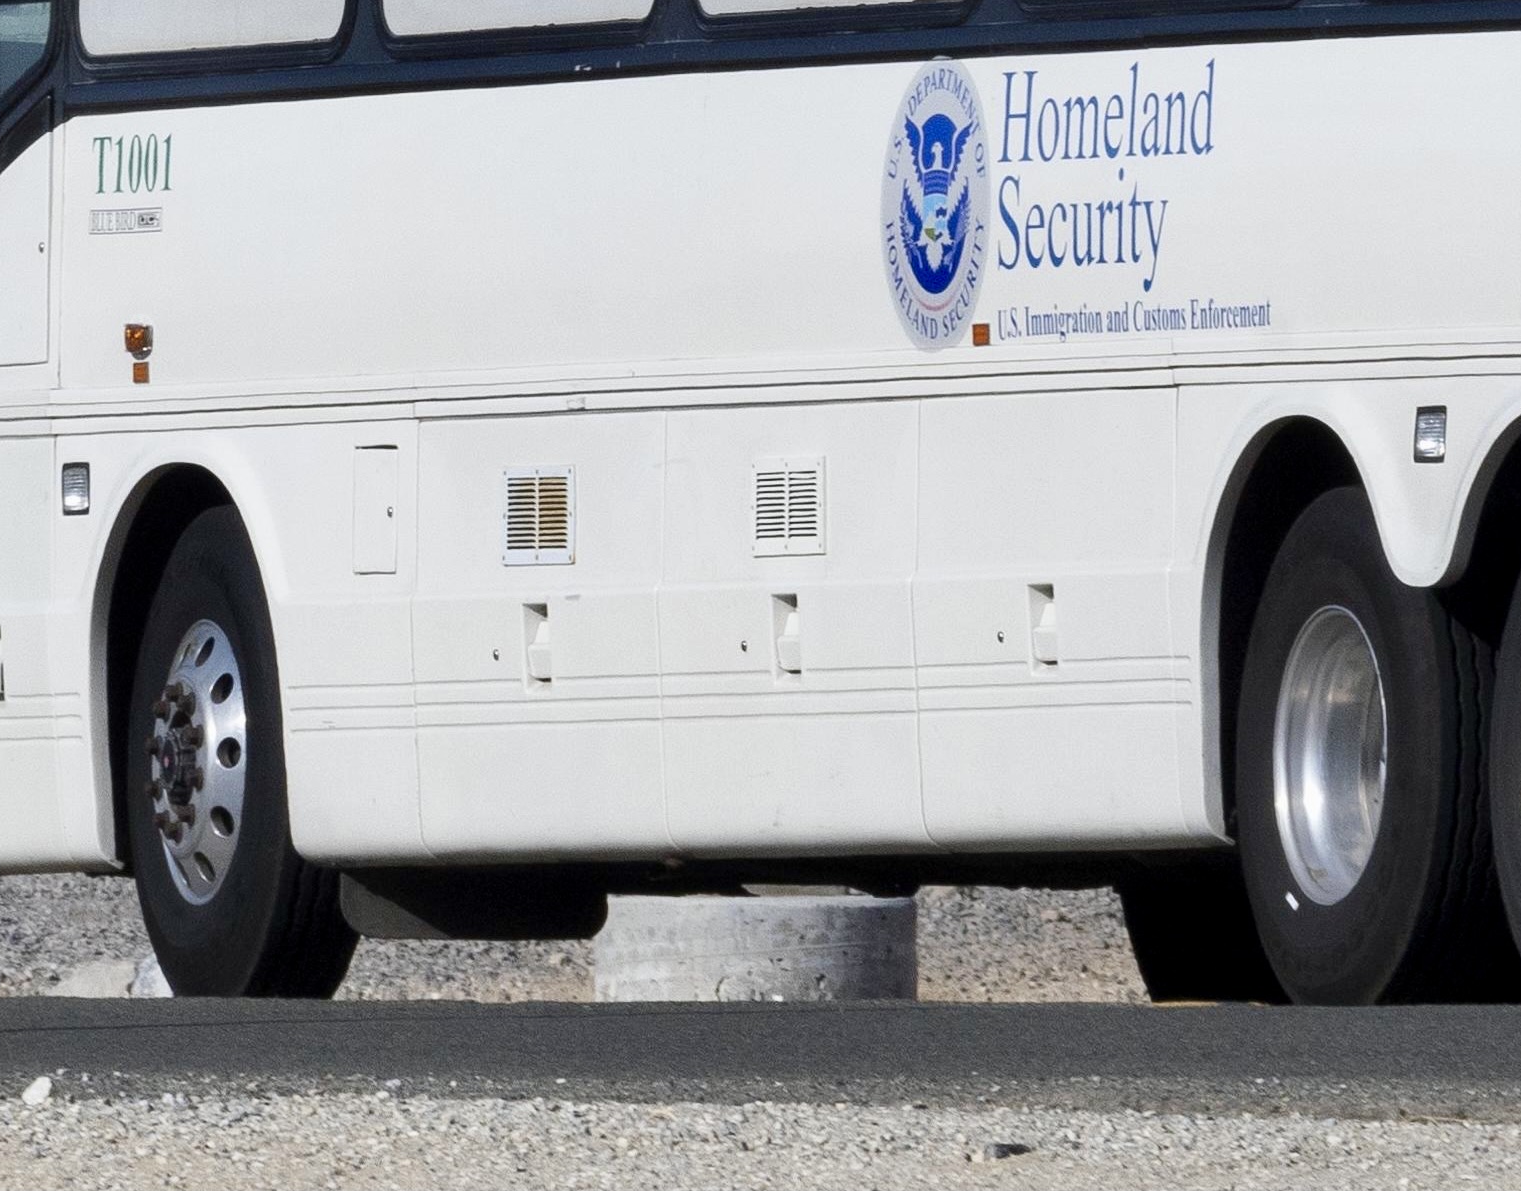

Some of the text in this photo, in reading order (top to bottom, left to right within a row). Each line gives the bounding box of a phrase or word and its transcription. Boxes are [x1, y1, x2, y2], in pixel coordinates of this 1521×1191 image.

[91, 133, 173, 195] T1001
[907, 68, 980, 135] DEPARTMENT
[974, 142, 986, 178] OF
[997, 57, 1216, 163] Homeland
[885, 218, 985, 340] HOMELAND SECURITY
[997, 167, 1169, 293] Security
[998, 297, 1272, 342] U.S. Immigration and Customs Enforcement
